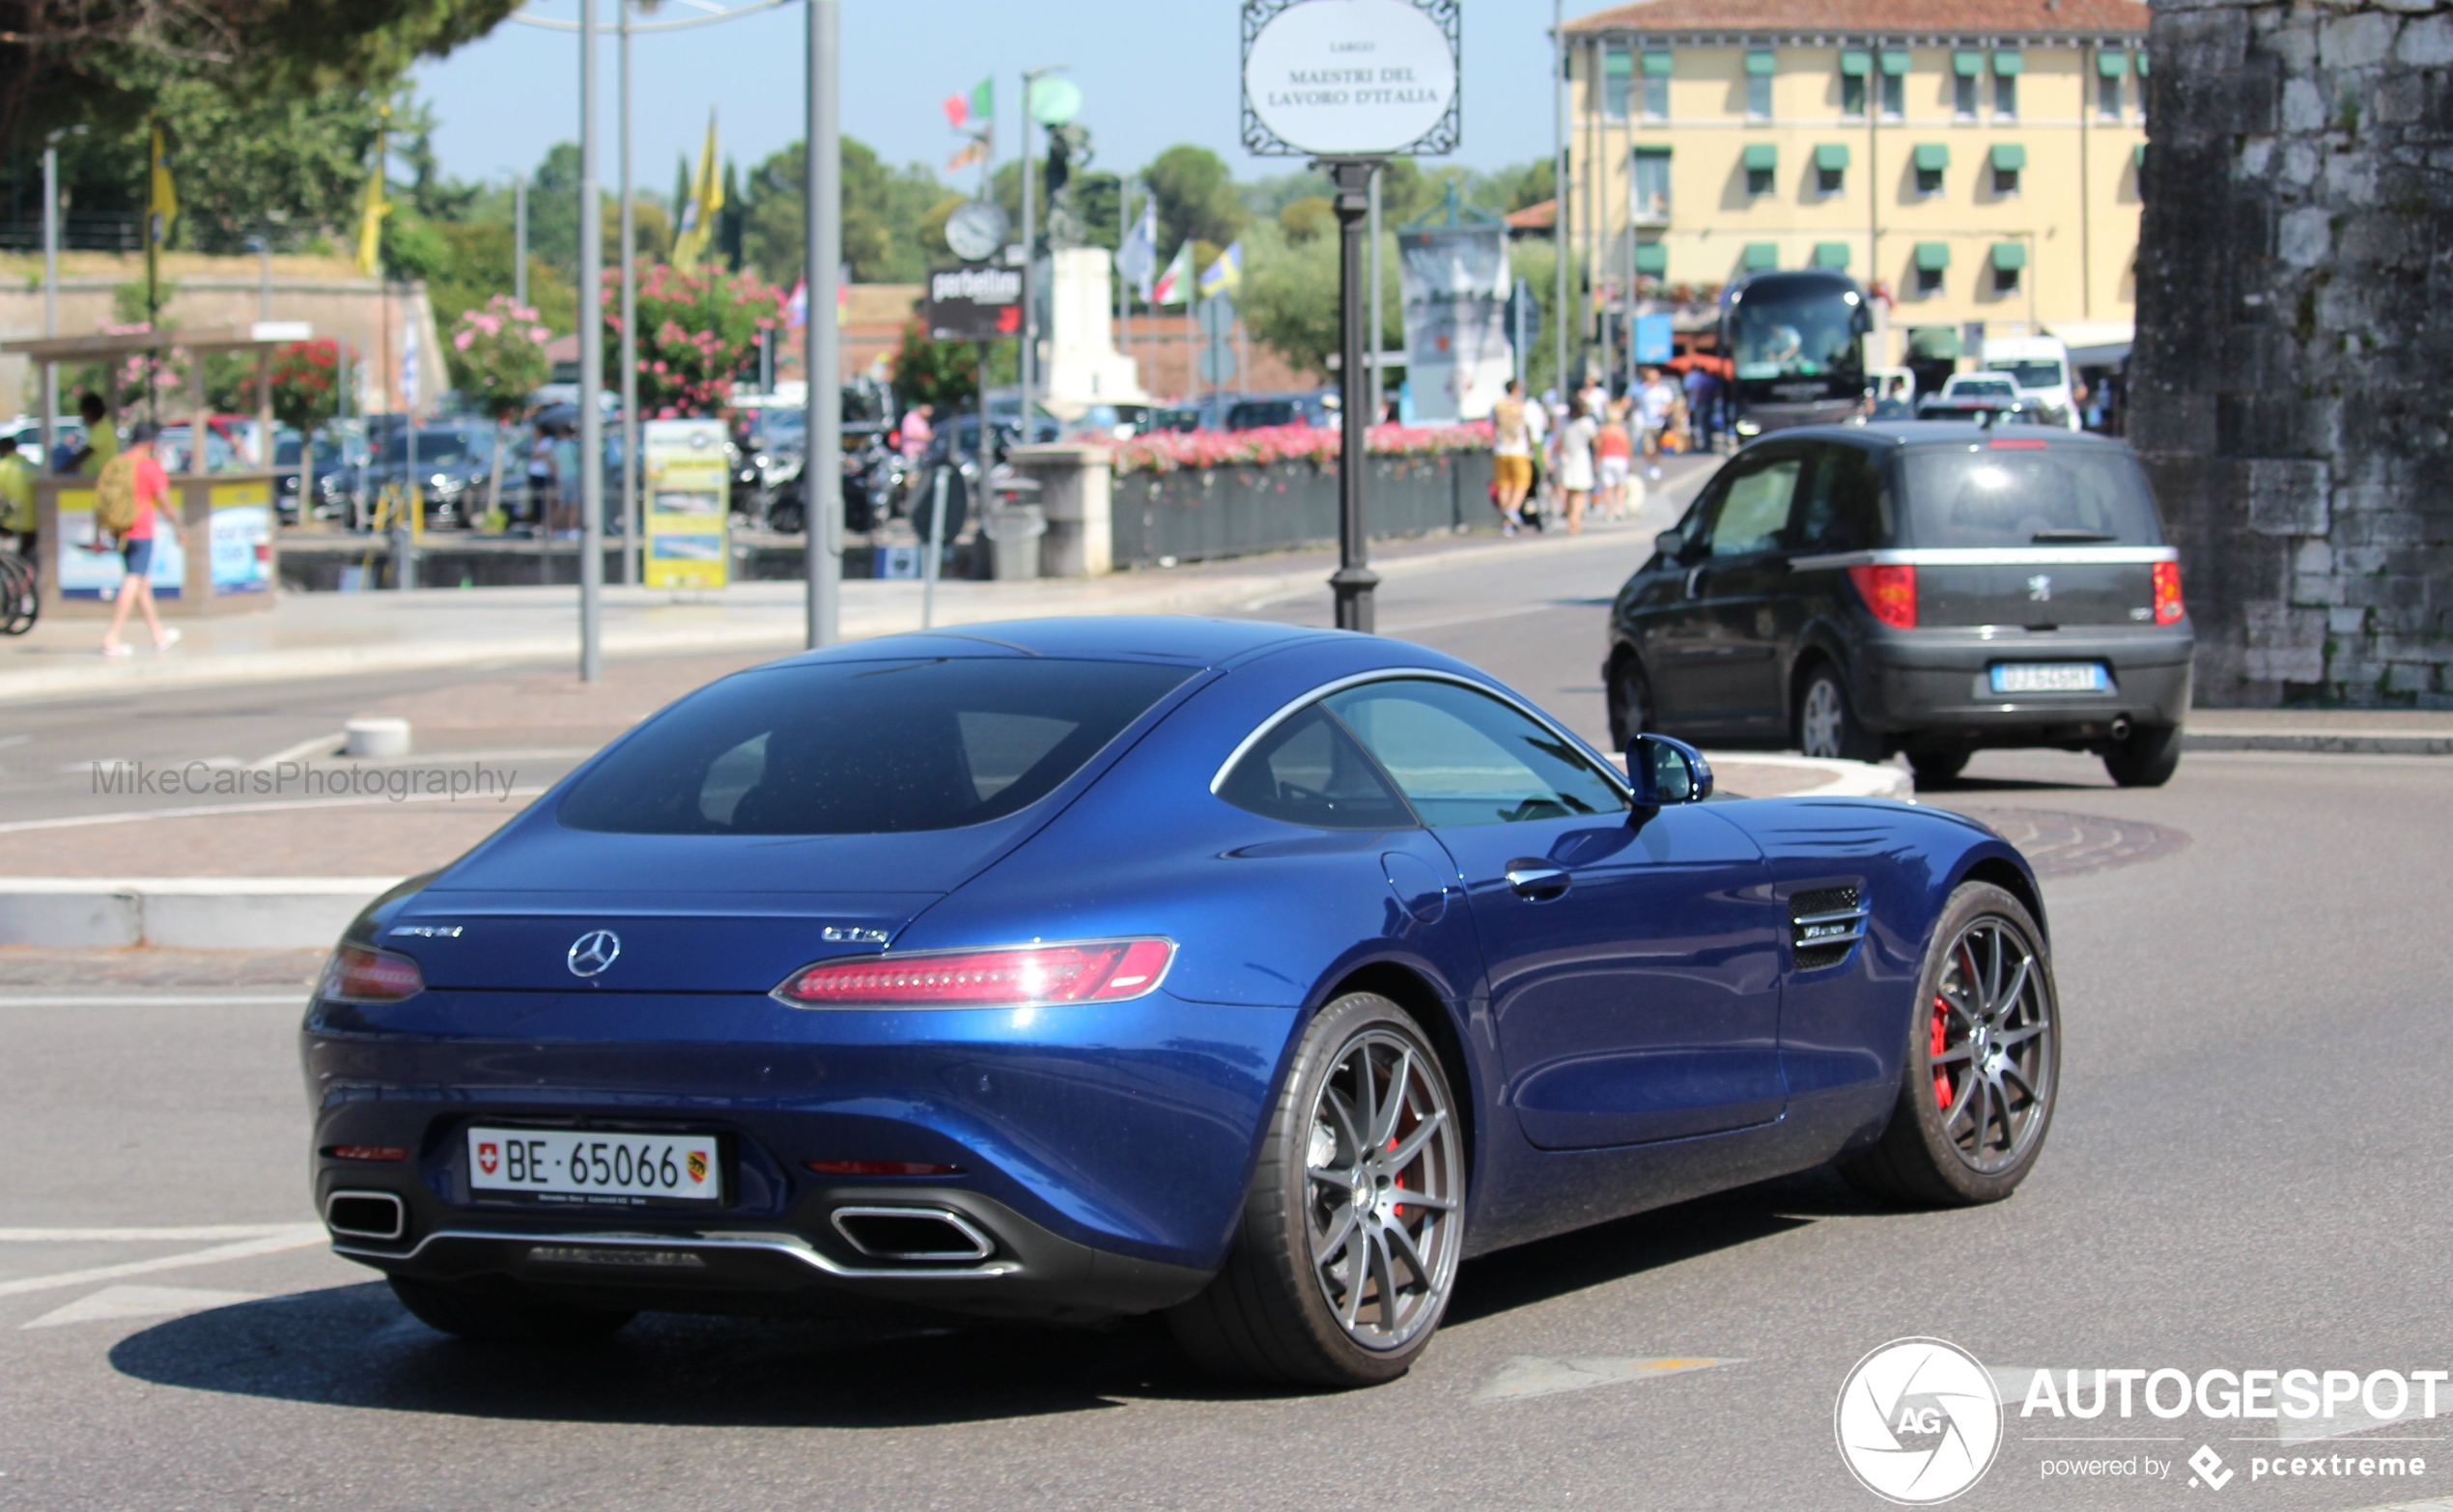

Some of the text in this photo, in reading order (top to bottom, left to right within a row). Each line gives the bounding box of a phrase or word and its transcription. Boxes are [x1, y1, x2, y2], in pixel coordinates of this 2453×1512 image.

[1329, 42, 1375, 52] LARGO
[1288, 68, 1416, 84] MAESTRI DEL
[1267, 88, 1438, 106] LAVORO D'ITALIA
[933, 267, 1022, 303] perbellini
